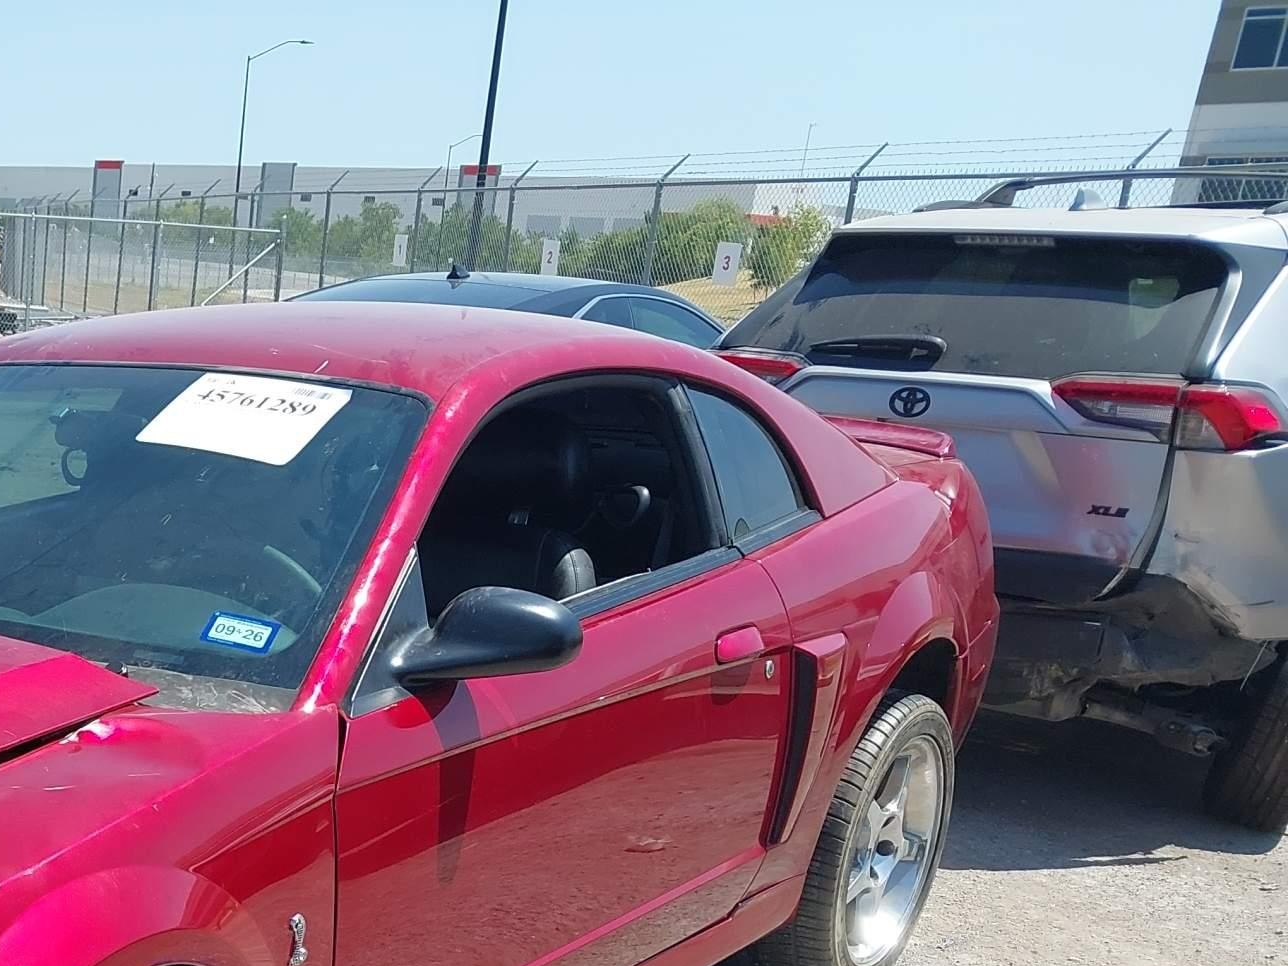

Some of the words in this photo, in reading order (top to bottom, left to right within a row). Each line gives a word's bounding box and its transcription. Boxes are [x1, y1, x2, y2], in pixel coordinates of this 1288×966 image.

[546, 250, 553, 264] 2
[722, 255, 731, 271] 3
[197, 387, 317, 416] 45761289
